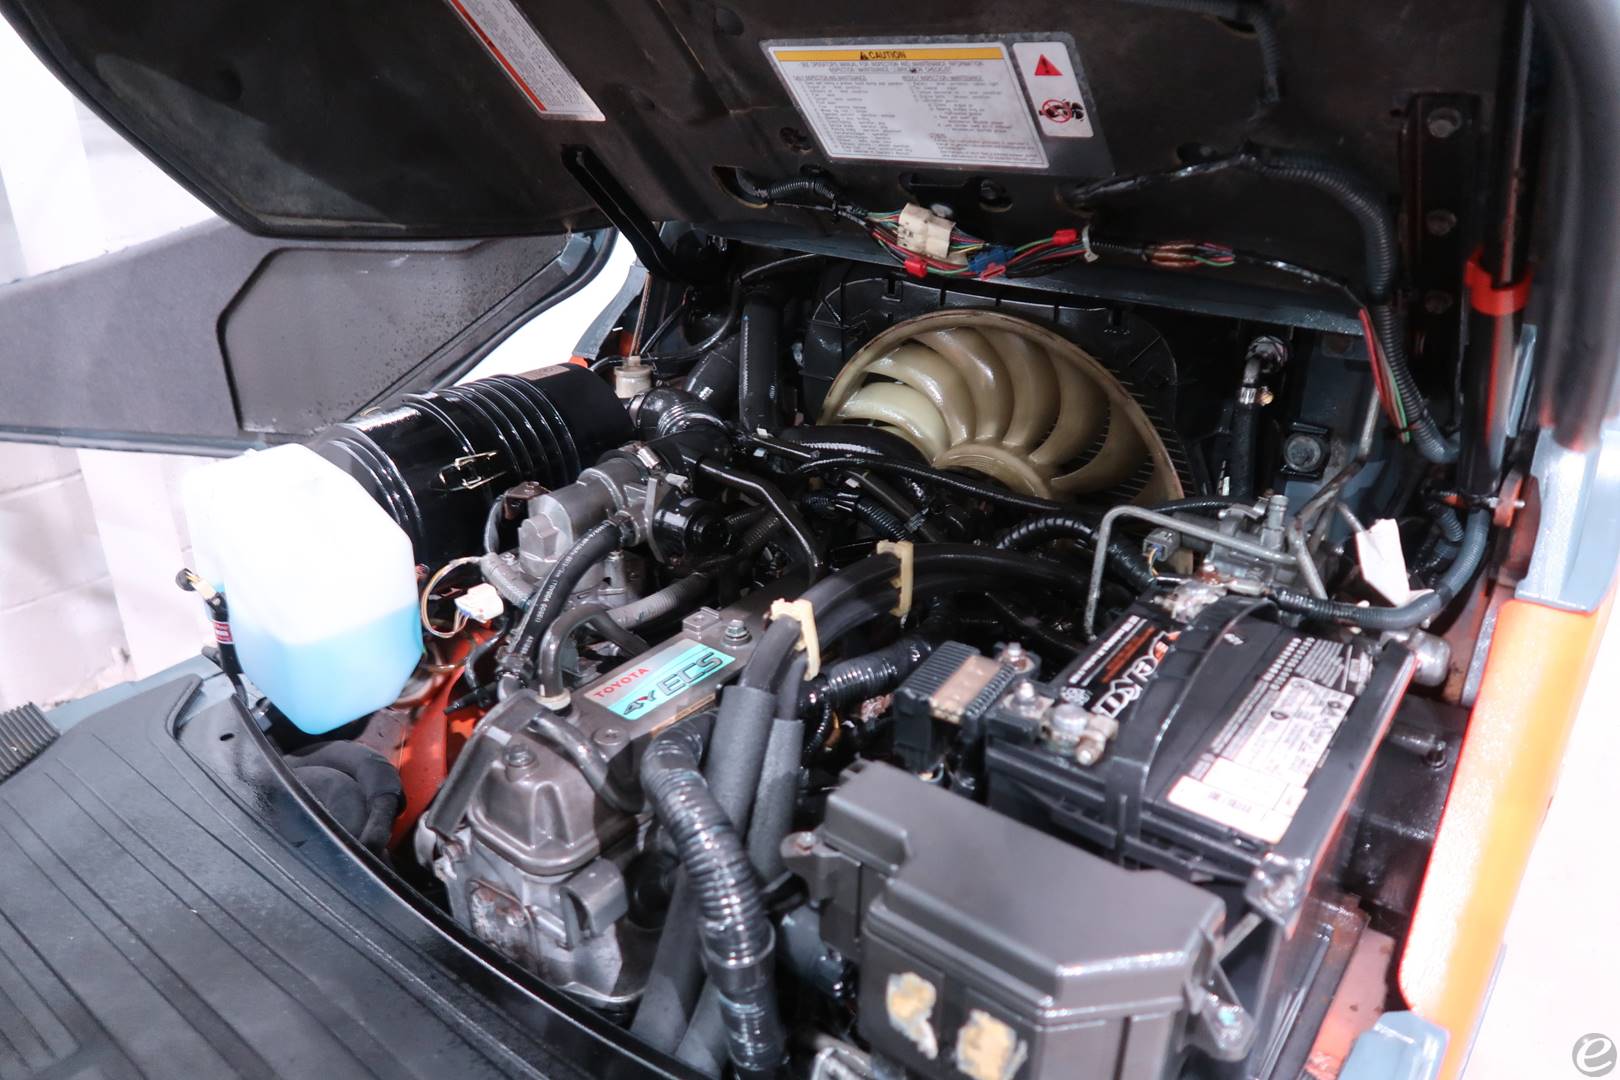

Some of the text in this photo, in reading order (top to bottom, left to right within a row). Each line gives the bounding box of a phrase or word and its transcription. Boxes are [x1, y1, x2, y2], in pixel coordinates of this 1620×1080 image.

[870, 51, 907, 59] CAUTION
[594, 667, 649, 698] TOYOTA
[656, 652, 723, 696] ECS
